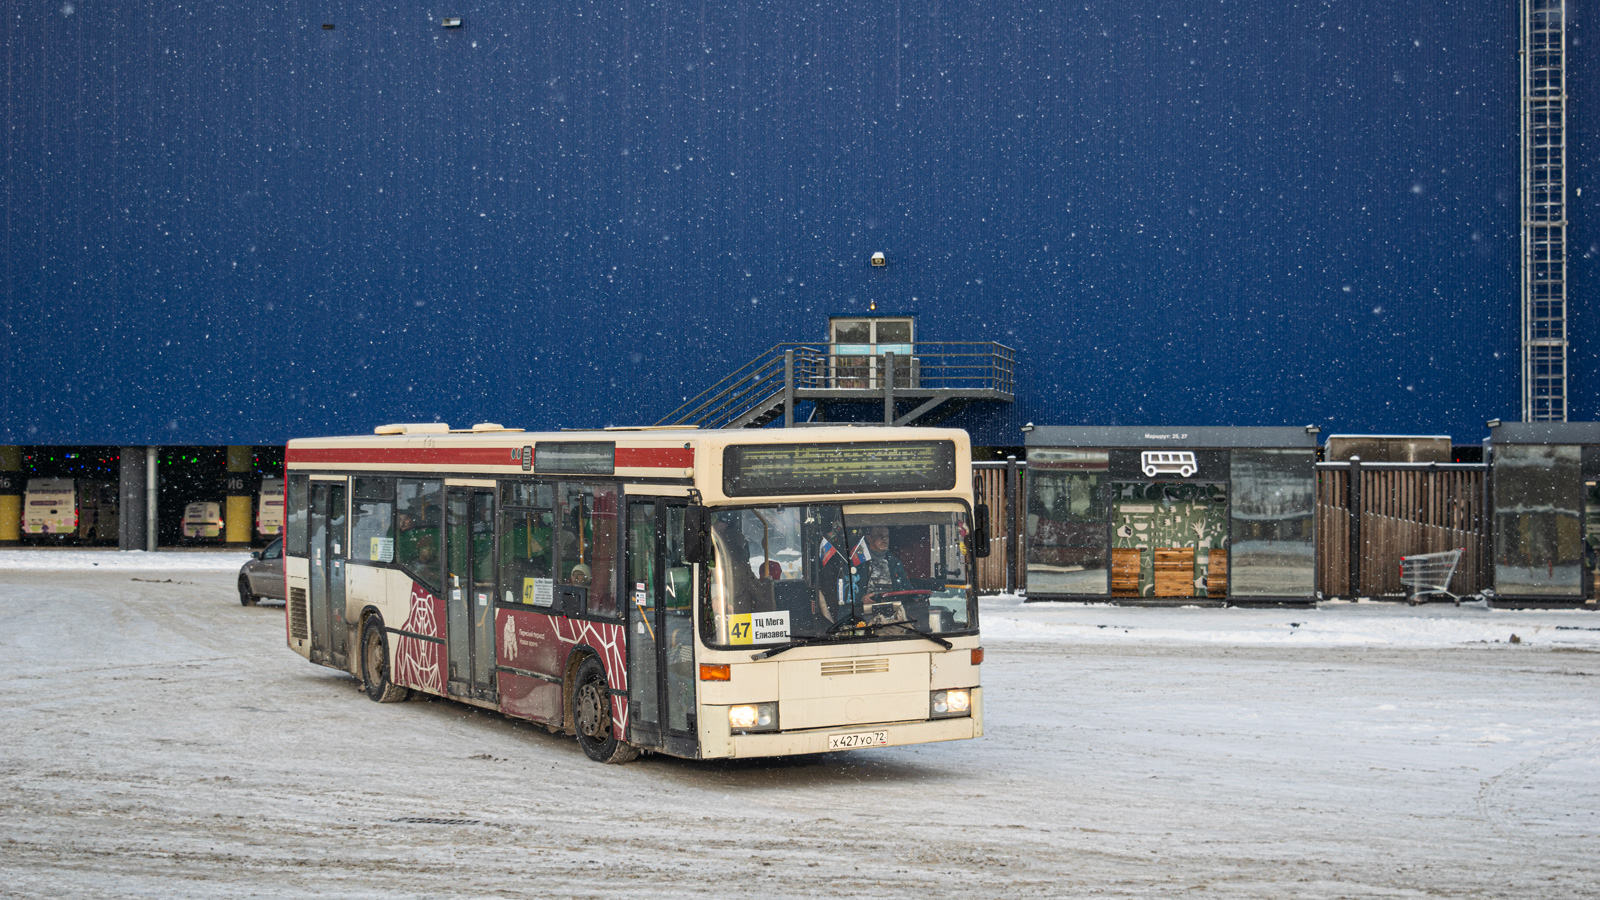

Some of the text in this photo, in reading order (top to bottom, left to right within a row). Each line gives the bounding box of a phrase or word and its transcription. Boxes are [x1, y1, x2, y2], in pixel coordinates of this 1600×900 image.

[228, 478, 244, 490] И6
[525, 584, 533, 599] 47
[754, 617, 784, 628] ТЦ Мега
[731, 622, 751, 638] 47
[755, 630, 787, 640] Елизавет
[875, 732, 885, 741] 72
